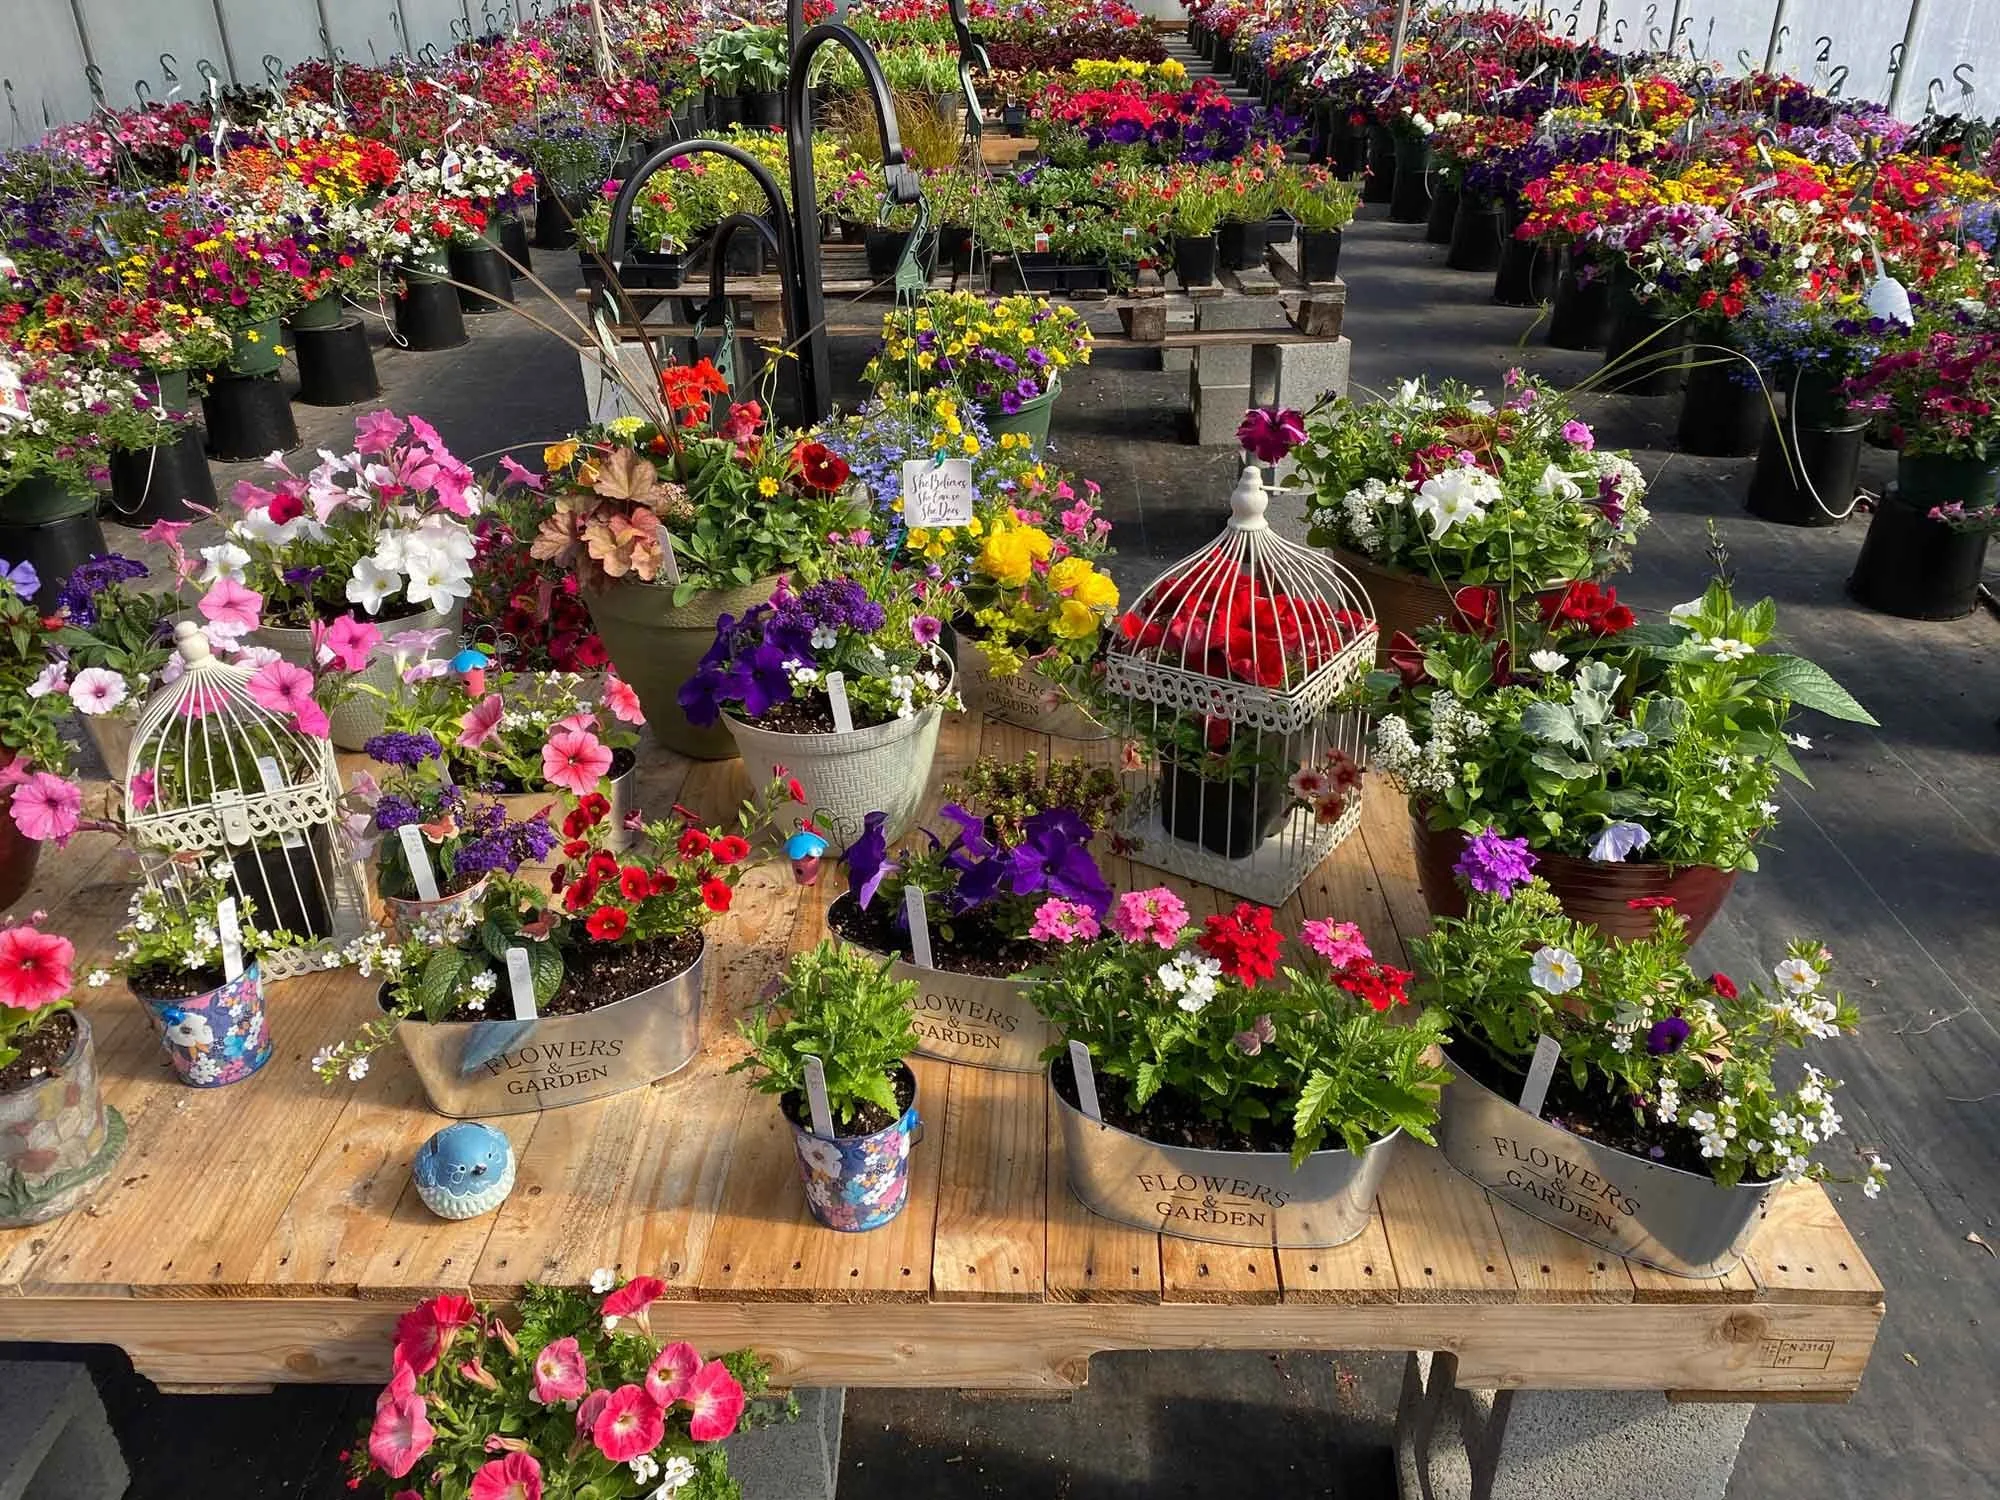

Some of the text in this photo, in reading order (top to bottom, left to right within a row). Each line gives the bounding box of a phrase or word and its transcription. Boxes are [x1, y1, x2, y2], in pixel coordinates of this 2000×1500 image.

[901, 992, 1020, 1033] LOWERS
[947, 1014, 961, 1029] &
[911, 1020, 1001, 1049] GARDEN
[483, 1039, 624, 1077] FLOWERS
[547, 1061, 564, 1075] &
[507, 1064, 609, 1095] GARDEN
[1136, 1173, 1290, 1209] FLOWERS
[1492, 1136, 1641, 1216] FLOWERS
[1551, 1177, 1569, 1195] &
[1155, 1201, 1266, 1227] GARDEN
[1202, 1194, 1219, 1209] &
[1506, 1169, 1614, 1230] GARDEN
